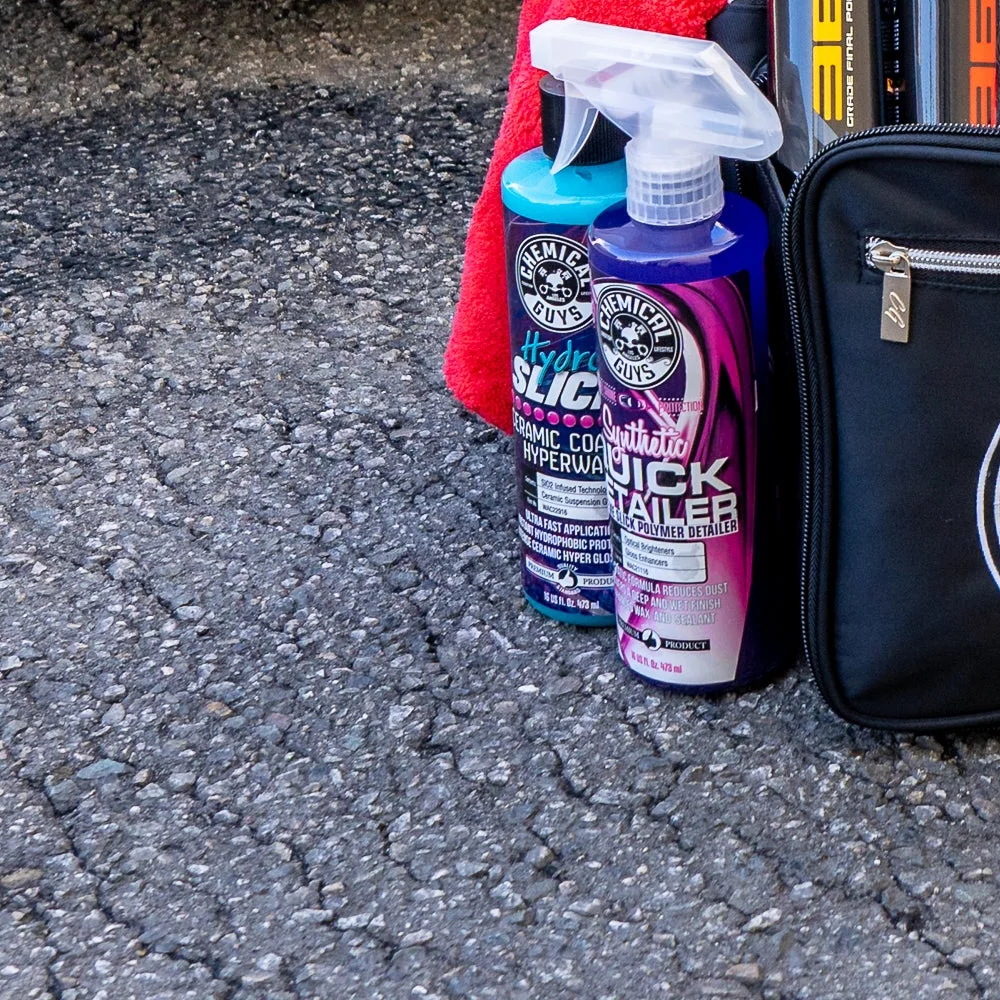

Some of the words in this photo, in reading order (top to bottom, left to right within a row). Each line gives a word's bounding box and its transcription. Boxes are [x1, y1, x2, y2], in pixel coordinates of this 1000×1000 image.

[845, 25, 854, 72] FINAL
[846, 75, 855, 128] GRADE
[520, 242, 592, 288] CHEMICAL
[532, 300, 583, 325] GUYS
[600, 293, 674, 343] CHEMICAL
[613, 357, 656, 383] GUYS
[513, 411, 561, 450] ERAMIC
[569, 432, 605, 453] COA
[602, 403, 690, 465] Synthetic
[523, 440, 604, 475] HYPERWA
[605, 443, 733, 496] UICK
[542, 490, 563, 503] Ceramic
[564, 496, 601, 508] Suspension
[578, 486, 607, 495] Technolo
[606, 474, 739, 527] ETAILER
[525, 508, 543, 528] ULTRA
[543, 518, 562, 534] FAST
[638, 521, 685, 539] POLYMER
[688, 519, 738, 539] DETAILER
[532, 538, 562, 561] CERAMIC
[563, 550, 592, 565] HYPER
[534, 527, 588, 551] HYDROPHOBIC
[589, 539, 612, 551] PROT
[583, 577, 613, 586] PRODU
[662, 585, 702, 597] REDUCES
[705, 582, 728, 597] DUST
[577, 599, 590, 610] 473
[590, 600, 600, 610] ml
[650, 598, 667, 610] AND
[670, 599, 689, 611] WET
[691, 598, 721, 611] FINISH
[654, 611, 671, 624] AND
[675, 613, 716, 626] SEALANT
[665, 639, 707, 650] PRODUCT
[660, 661, 672, 673] 473
[673, 663, 683, 674] ml
